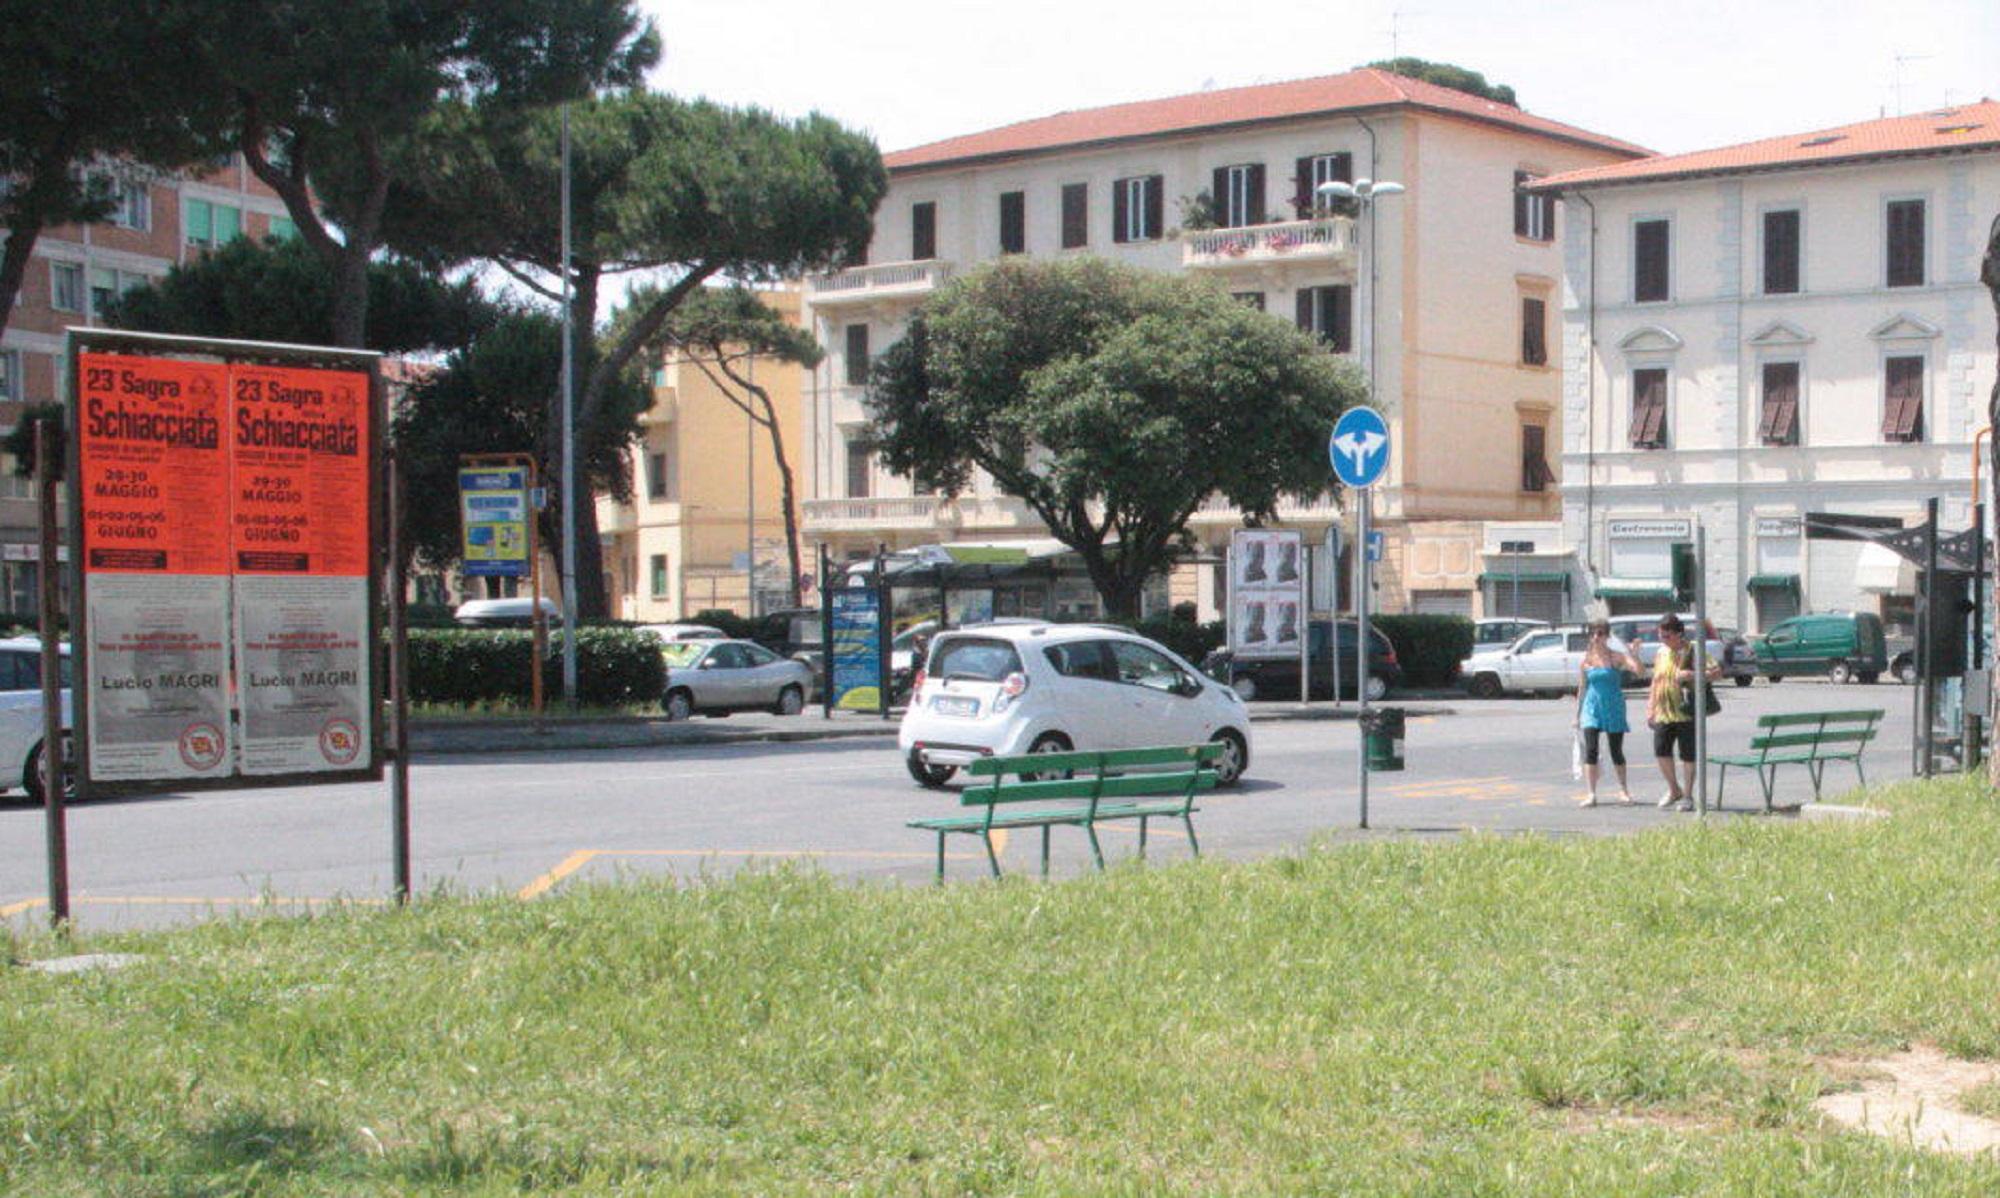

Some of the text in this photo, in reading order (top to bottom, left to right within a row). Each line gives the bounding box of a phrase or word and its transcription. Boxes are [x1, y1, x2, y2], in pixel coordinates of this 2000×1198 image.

[87, 368, 180, 401] 23 Sagra
[236, 378, 323, 409] 23 Sagra
[88, 398, 218, 446] Schiacciata
[237, 407, 357, 452] Schiacciata
[95, 482, 159, 499] MAGGIO
[242, 489, 302, 504] MAGGIO
[97, 525, 157, 539] GIUGNO
[244, 528, 300, 543] GIUGNO
[101, 674, 220, 689] Lucio MAGRI
[250, 670, 357, 688] Lucio MAGRI
